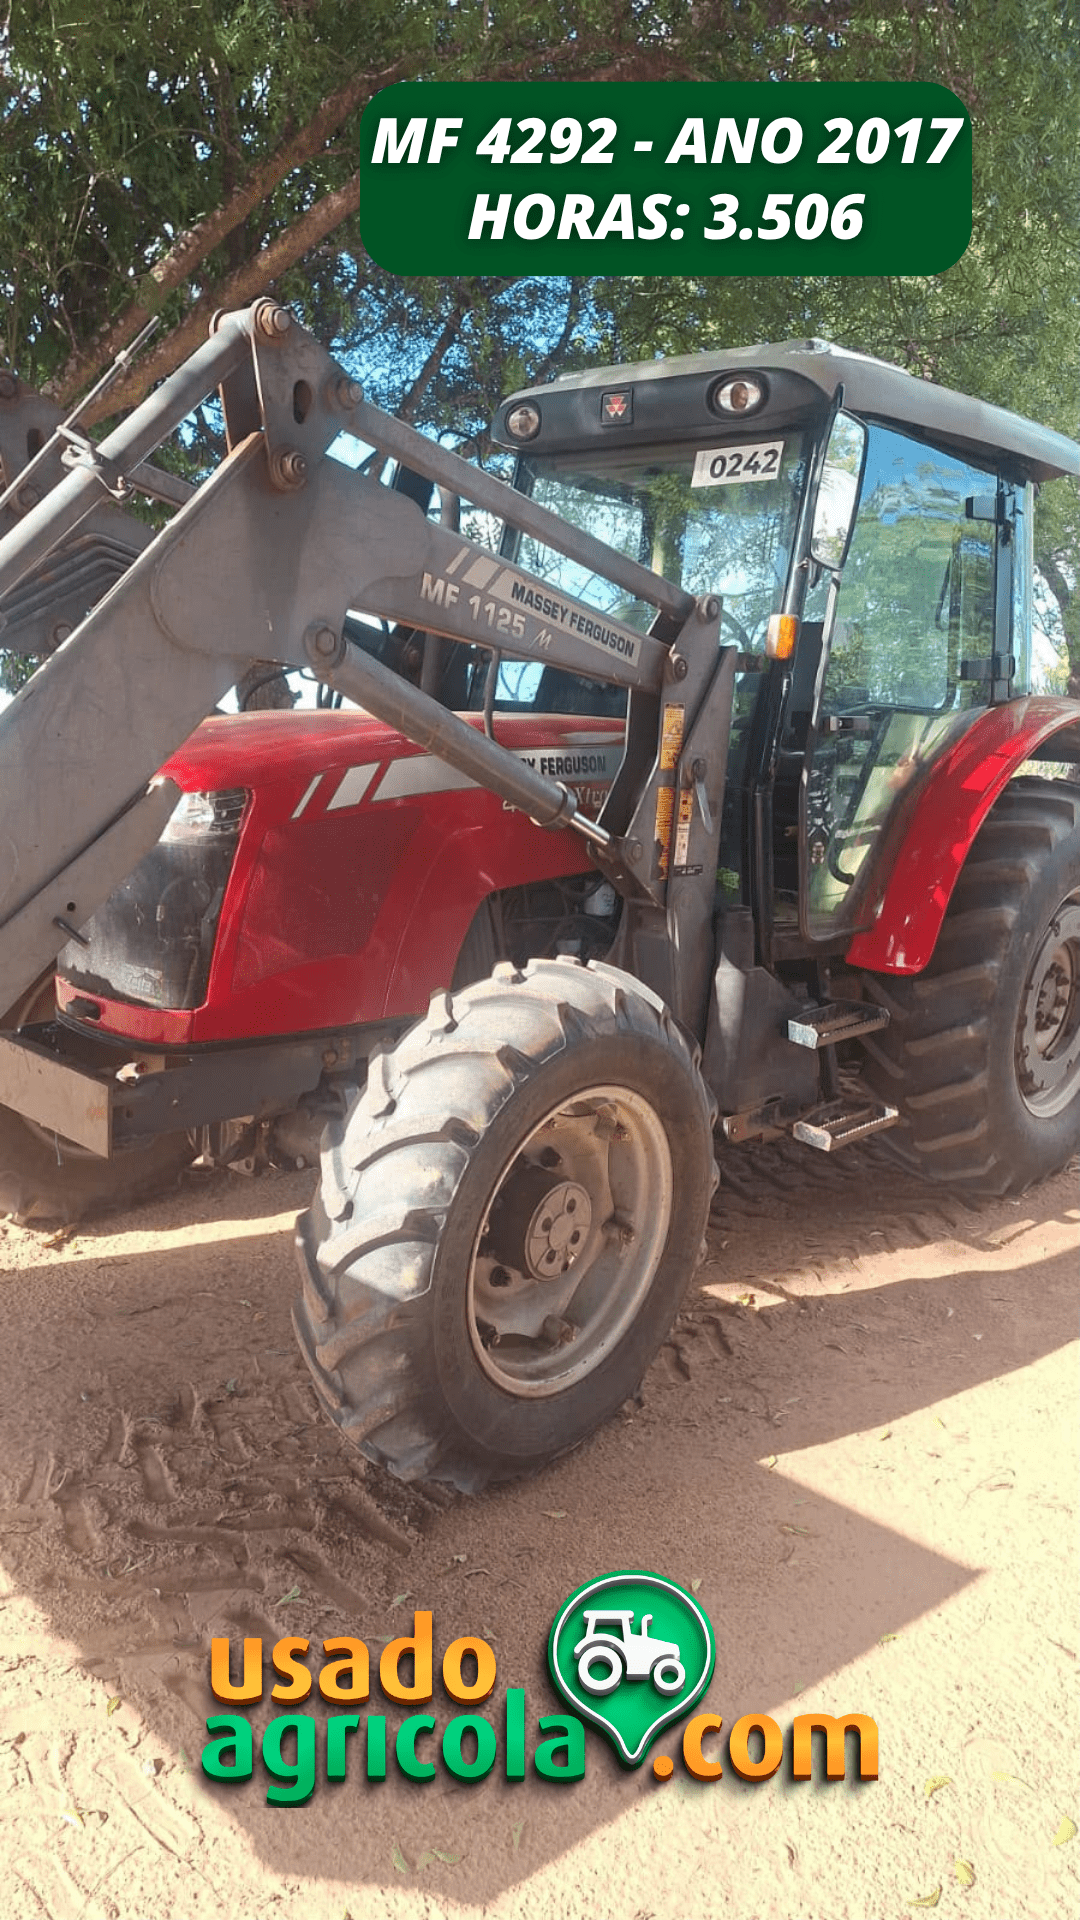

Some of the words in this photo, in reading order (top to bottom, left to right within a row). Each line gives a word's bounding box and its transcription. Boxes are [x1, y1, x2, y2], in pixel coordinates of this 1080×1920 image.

[709, 448, 779, 479] 0242
[419, 571, 460, 609] MF
[468, 595, 527, 639] 1125
[511, 581, 570, 623] MASSEY
[568, 611, 636, 659] FERGUSON
[540, 755, 607, 776] FERGUSON
